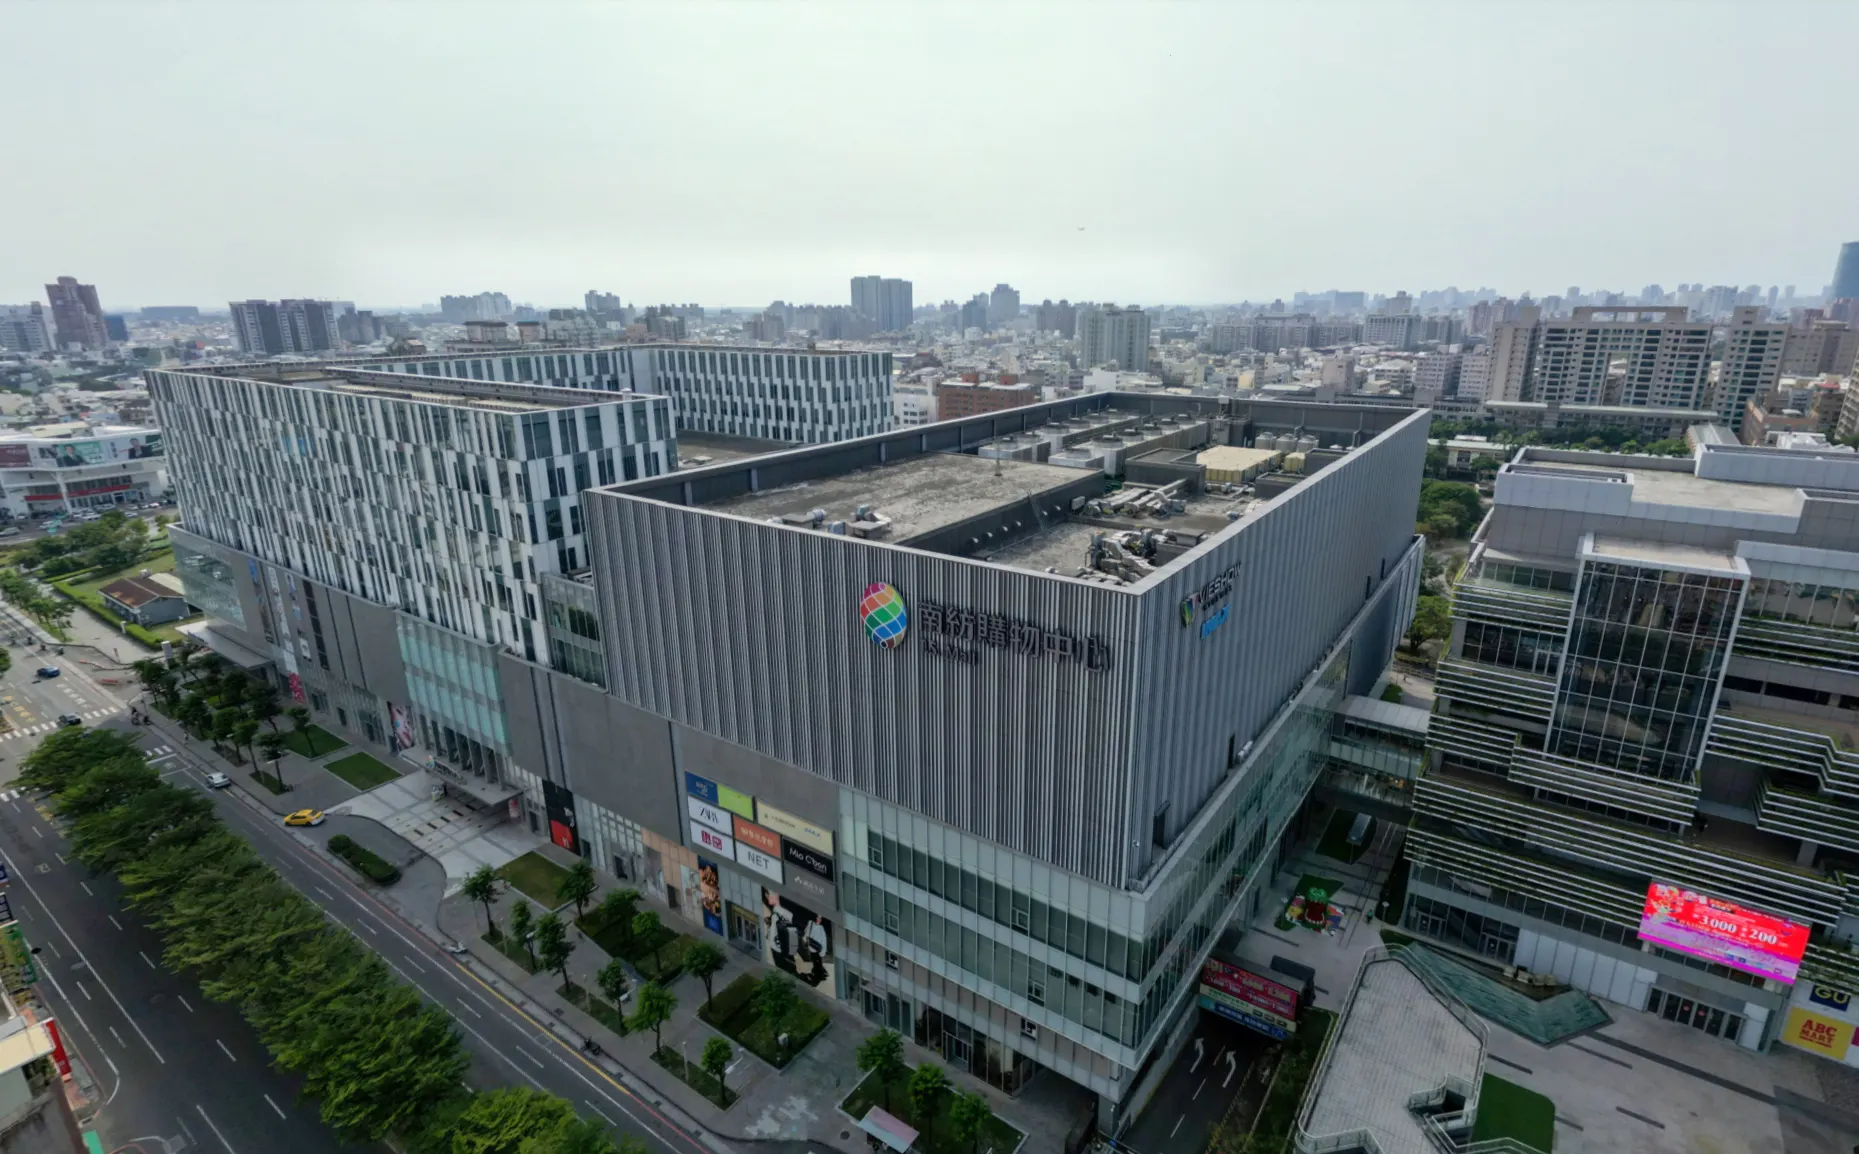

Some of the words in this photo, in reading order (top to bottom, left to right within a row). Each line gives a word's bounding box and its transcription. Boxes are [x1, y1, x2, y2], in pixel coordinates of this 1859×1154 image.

[917, 600, 1111, 674] 南紡購物中心
[945, 644, 978, 666] Mall
[747, 851, 769, 870] NET
[789, 847, 804, 861] Mio
[1749, 927, 1779, 946] 200
[1815, 985, 1849, 1005] GU
[1800, 1028, 1834, 1044] MART
[1802, 1019, 1837, 1037] ABC
